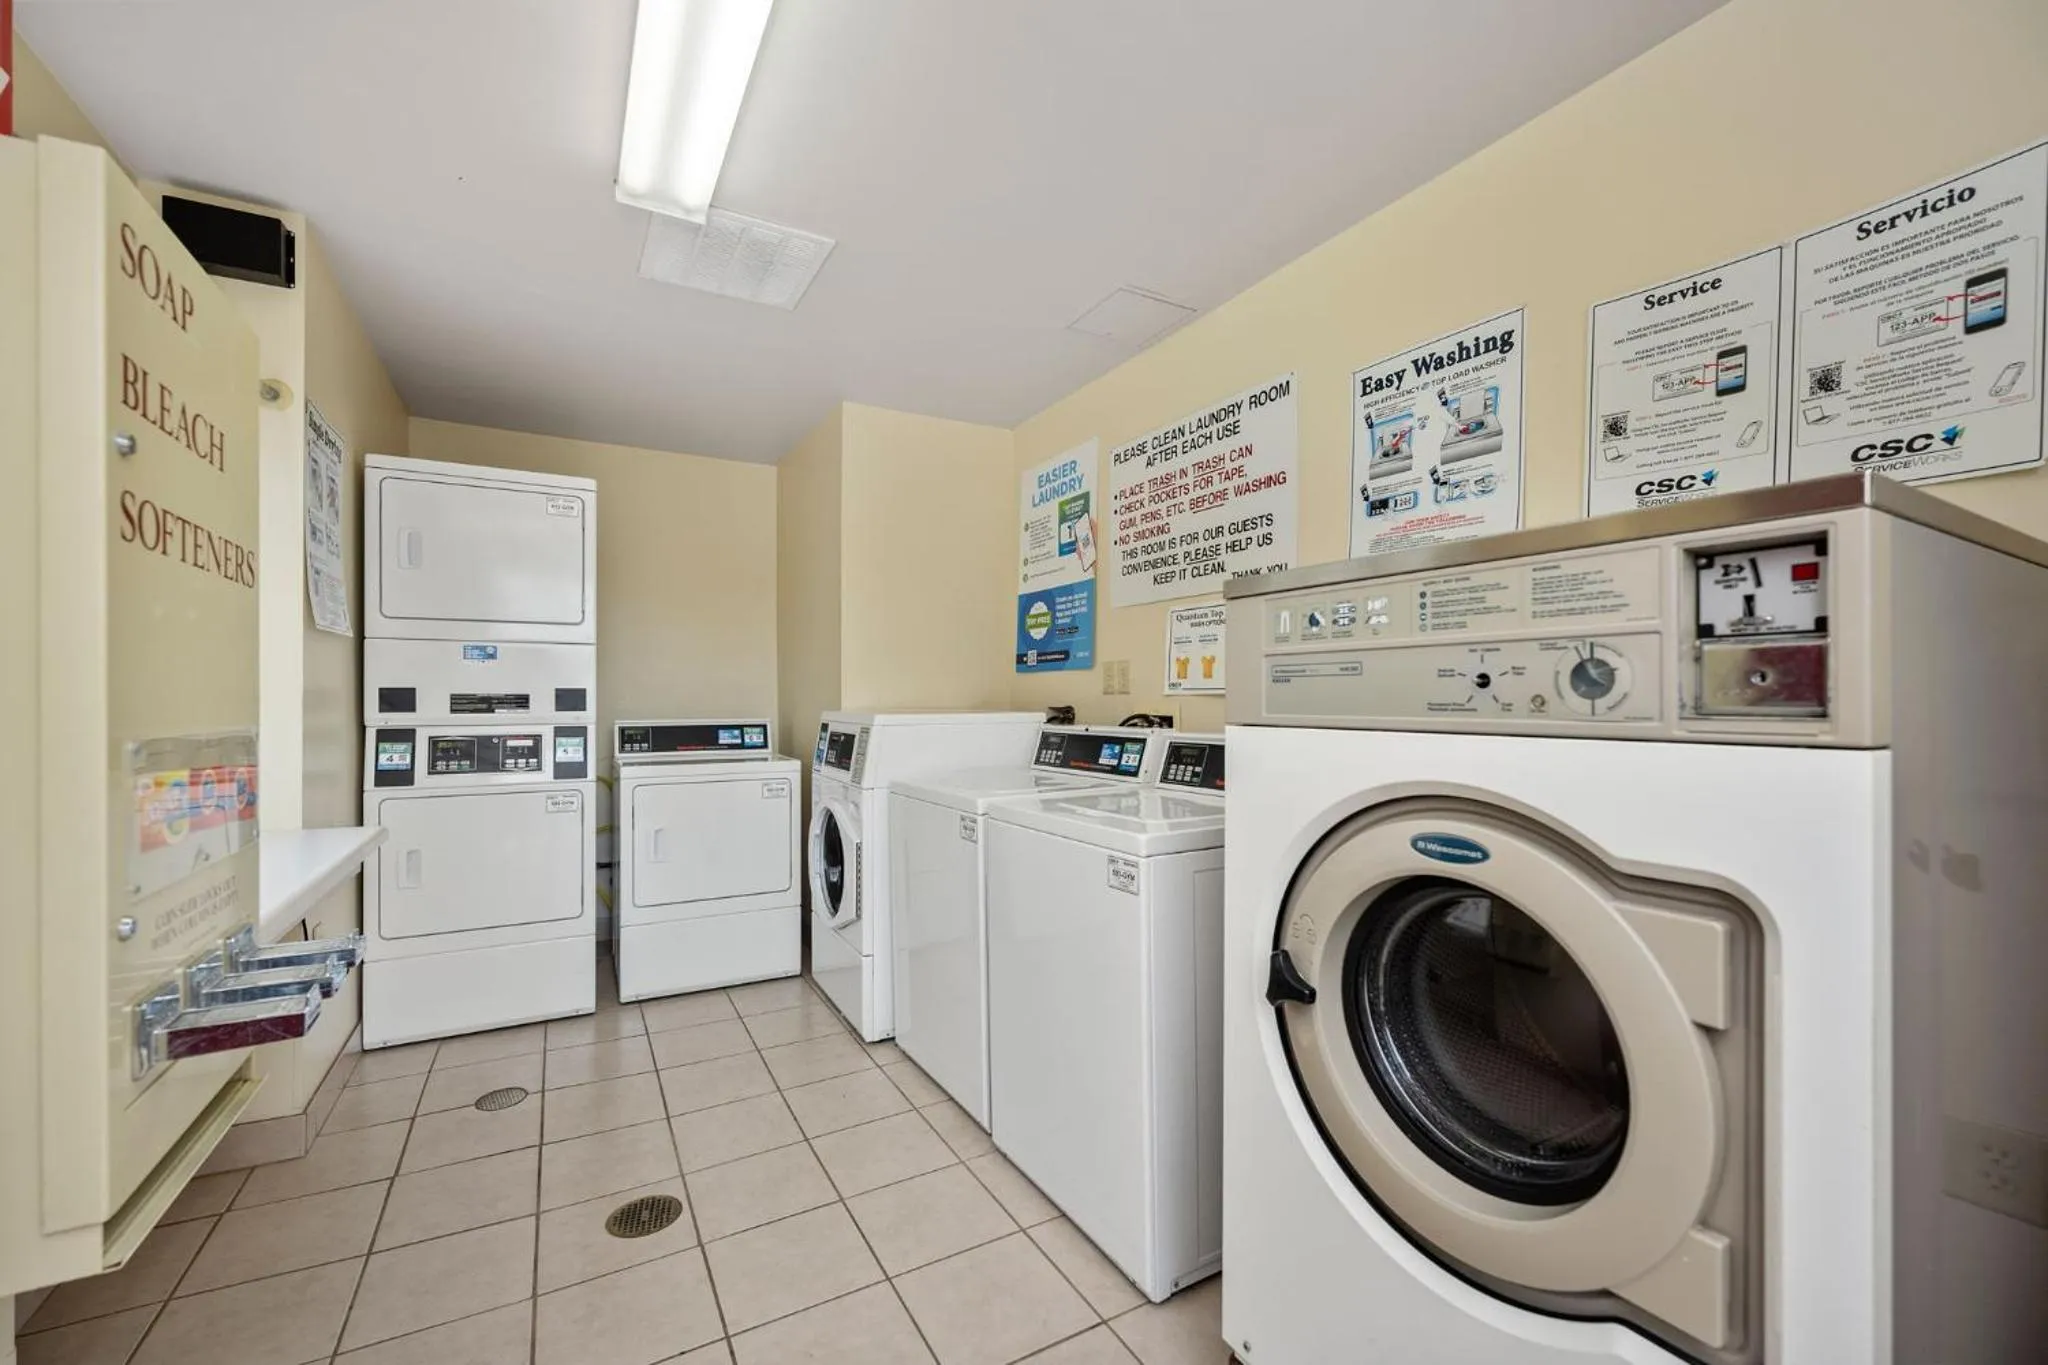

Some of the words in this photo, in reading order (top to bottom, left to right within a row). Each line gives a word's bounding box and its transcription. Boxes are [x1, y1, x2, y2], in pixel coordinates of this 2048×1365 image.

[1856, 186, 1976, 241] Servicio
[1892, 224, 1946, 249] IMPORTANTE
[1948, 213, 1971, 229] PARA
[1973, 194, 2024, 219] NOSOTROS
[1859, 235, 1933, 267] FUNCIONAMIENTO
[1936, 217, 1987, 240] APROPIADO
[1913, 237, 1951, 258] NUESTRA
[1953, 219, 2004, 242] PRIORIDAD
[121, 222, 194, 333] SOAP
[1644, 277, 1723, 311] Service
[1359, 368, 1407, 398] Easy
[1411, 328, 1515, 377] Washing
[1449, 368, 1471, 382] LOAD
[1472, 356, 1507, 374] WASHER
[121, 352, 225, 473] BLEACH
[1113, 440, 1148, 466] PLEASE
[1151, 424, 1186, 450] CLEAN
[1188, 400, 1244, 435] LAUNDRY
[1248, 380, 1290, 410] ROOM
[1145, 445, 1178, 470] AFTER
[1181, 430, 1213, 455] EACH
[1217, 420, 1241, 441] USE
[1850, 433, 1935, 463] CSC
[1032, 473, 1084, 508] LAUNDRY
[1038, 460, 1077, 489] EASIER
[1119, 482, 1145, 501] PLACE
[1148, 473, 1176, 492] TRASH
[1179, 467, 1189, 480] IN
[1192, 453, 1225, 475] TRASH
[1229, 443, 1253, 463] CAN
[1635, 475, 1697, 496] CSC
[1119, 497, 1146, 516] CHECK
[1148, 483, 1190, 505] POCKETS
[1192, 476, 1213, 492] FOR
[1166, 502, 1186, 517] ETC.
[1189, 488, 1230, 511] BEFORE
[1234, 471, 1287, 498] WASHING
[120, 489, 256, 589] SOFTENERS
[1118, 534, 1131, 547] NO
[1132, 522, 1171, 543] SMOKING
[1121, 549, 1138, 562] THIS
[1141, 540, 1166, 557] ROOM
[1168, 537, 1177, 549] IS
[1180, 531, 1200, 547] FOR
[1202, 525, 1225, 542] OUR
[1228, 513, 1274, 535] GUESTS
[1183, 544, 1221, 563] PLEASE
[1225, 537, 1253, 555] HELP
[1257, 532, 1274, 548] US
[1153, 569, 1177, 586] KEEP
[1179, 567, 1187, 581] IT
[1191, 561, 1227, 579] CLEAN.
[1177, 612, 1208, 623] Quantum
[1211, 609, 1224, 619] Top
